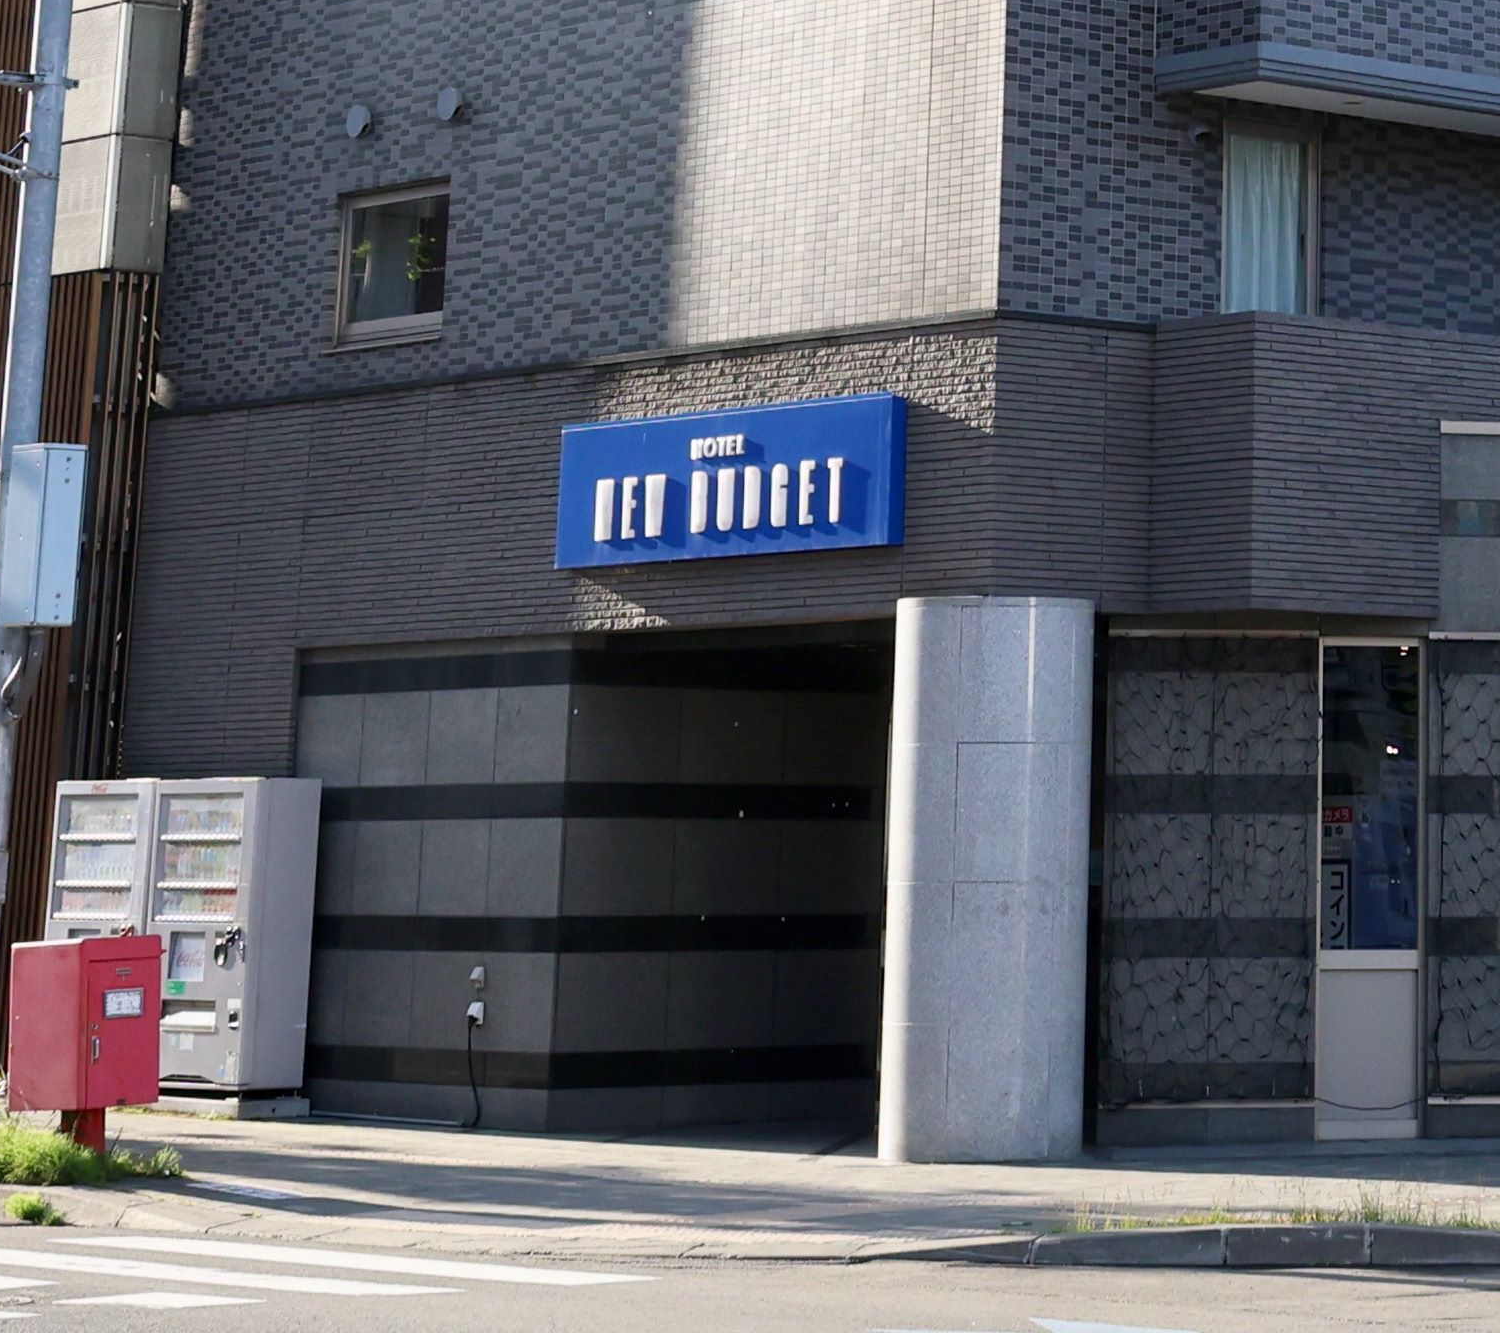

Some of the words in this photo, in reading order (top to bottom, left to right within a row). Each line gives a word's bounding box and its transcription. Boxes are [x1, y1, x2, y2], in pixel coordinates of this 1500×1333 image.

[691, 434, 744, 460] HOTEL
[690, 457, 844, 534] BUDGET
[1329, 870, 1345, 949] コイン
